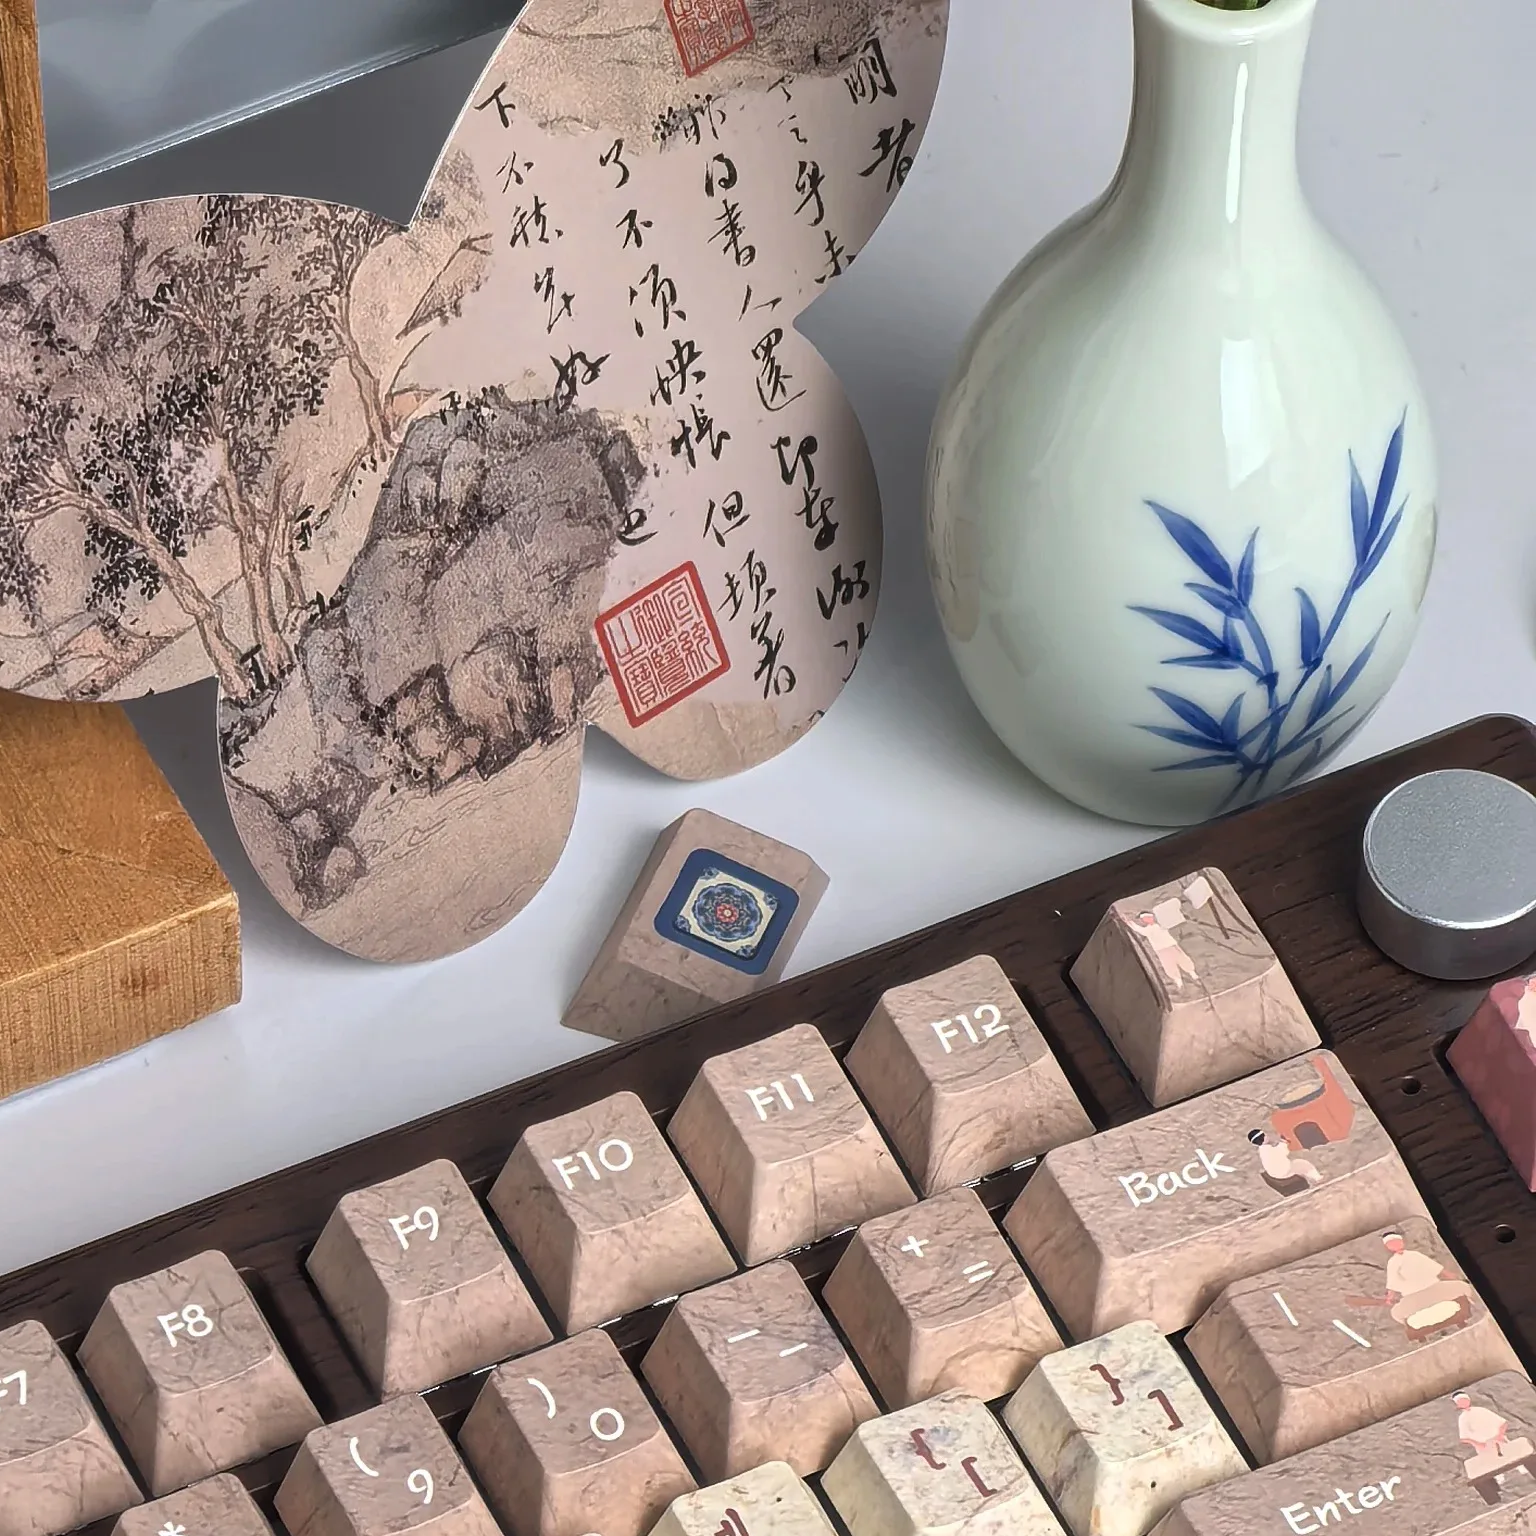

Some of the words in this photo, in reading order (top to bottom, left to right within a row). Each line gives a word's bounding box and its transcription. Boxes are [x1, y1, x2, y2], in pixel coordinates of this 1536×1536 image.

[930, 1004, 1010, 1054] F12
[744, 1073, 815, 1121] F11
[551, 1138, 634, 1190] F10
[1117, 1148, 1237, 1208] Back
[388, 1206, 439, 1250] F9
[900, 1235, 929, 1258] +
[962, 1260, 995, 1284] =
[156, 1304, 214, 1348] F8
[527, 1377, 556, 1419] )
[1089, 1363, 1125, 1407] }
[1147, 1388, 1184, 1432] ]
[349, 1436, 379, 1477] (
[407, 1468, 434, 1505] 9
[906, 1428, 947, 1471] {
[960, 1456, 1001, 1498] [
[1279, 1475, 1401, 1535] Enter
